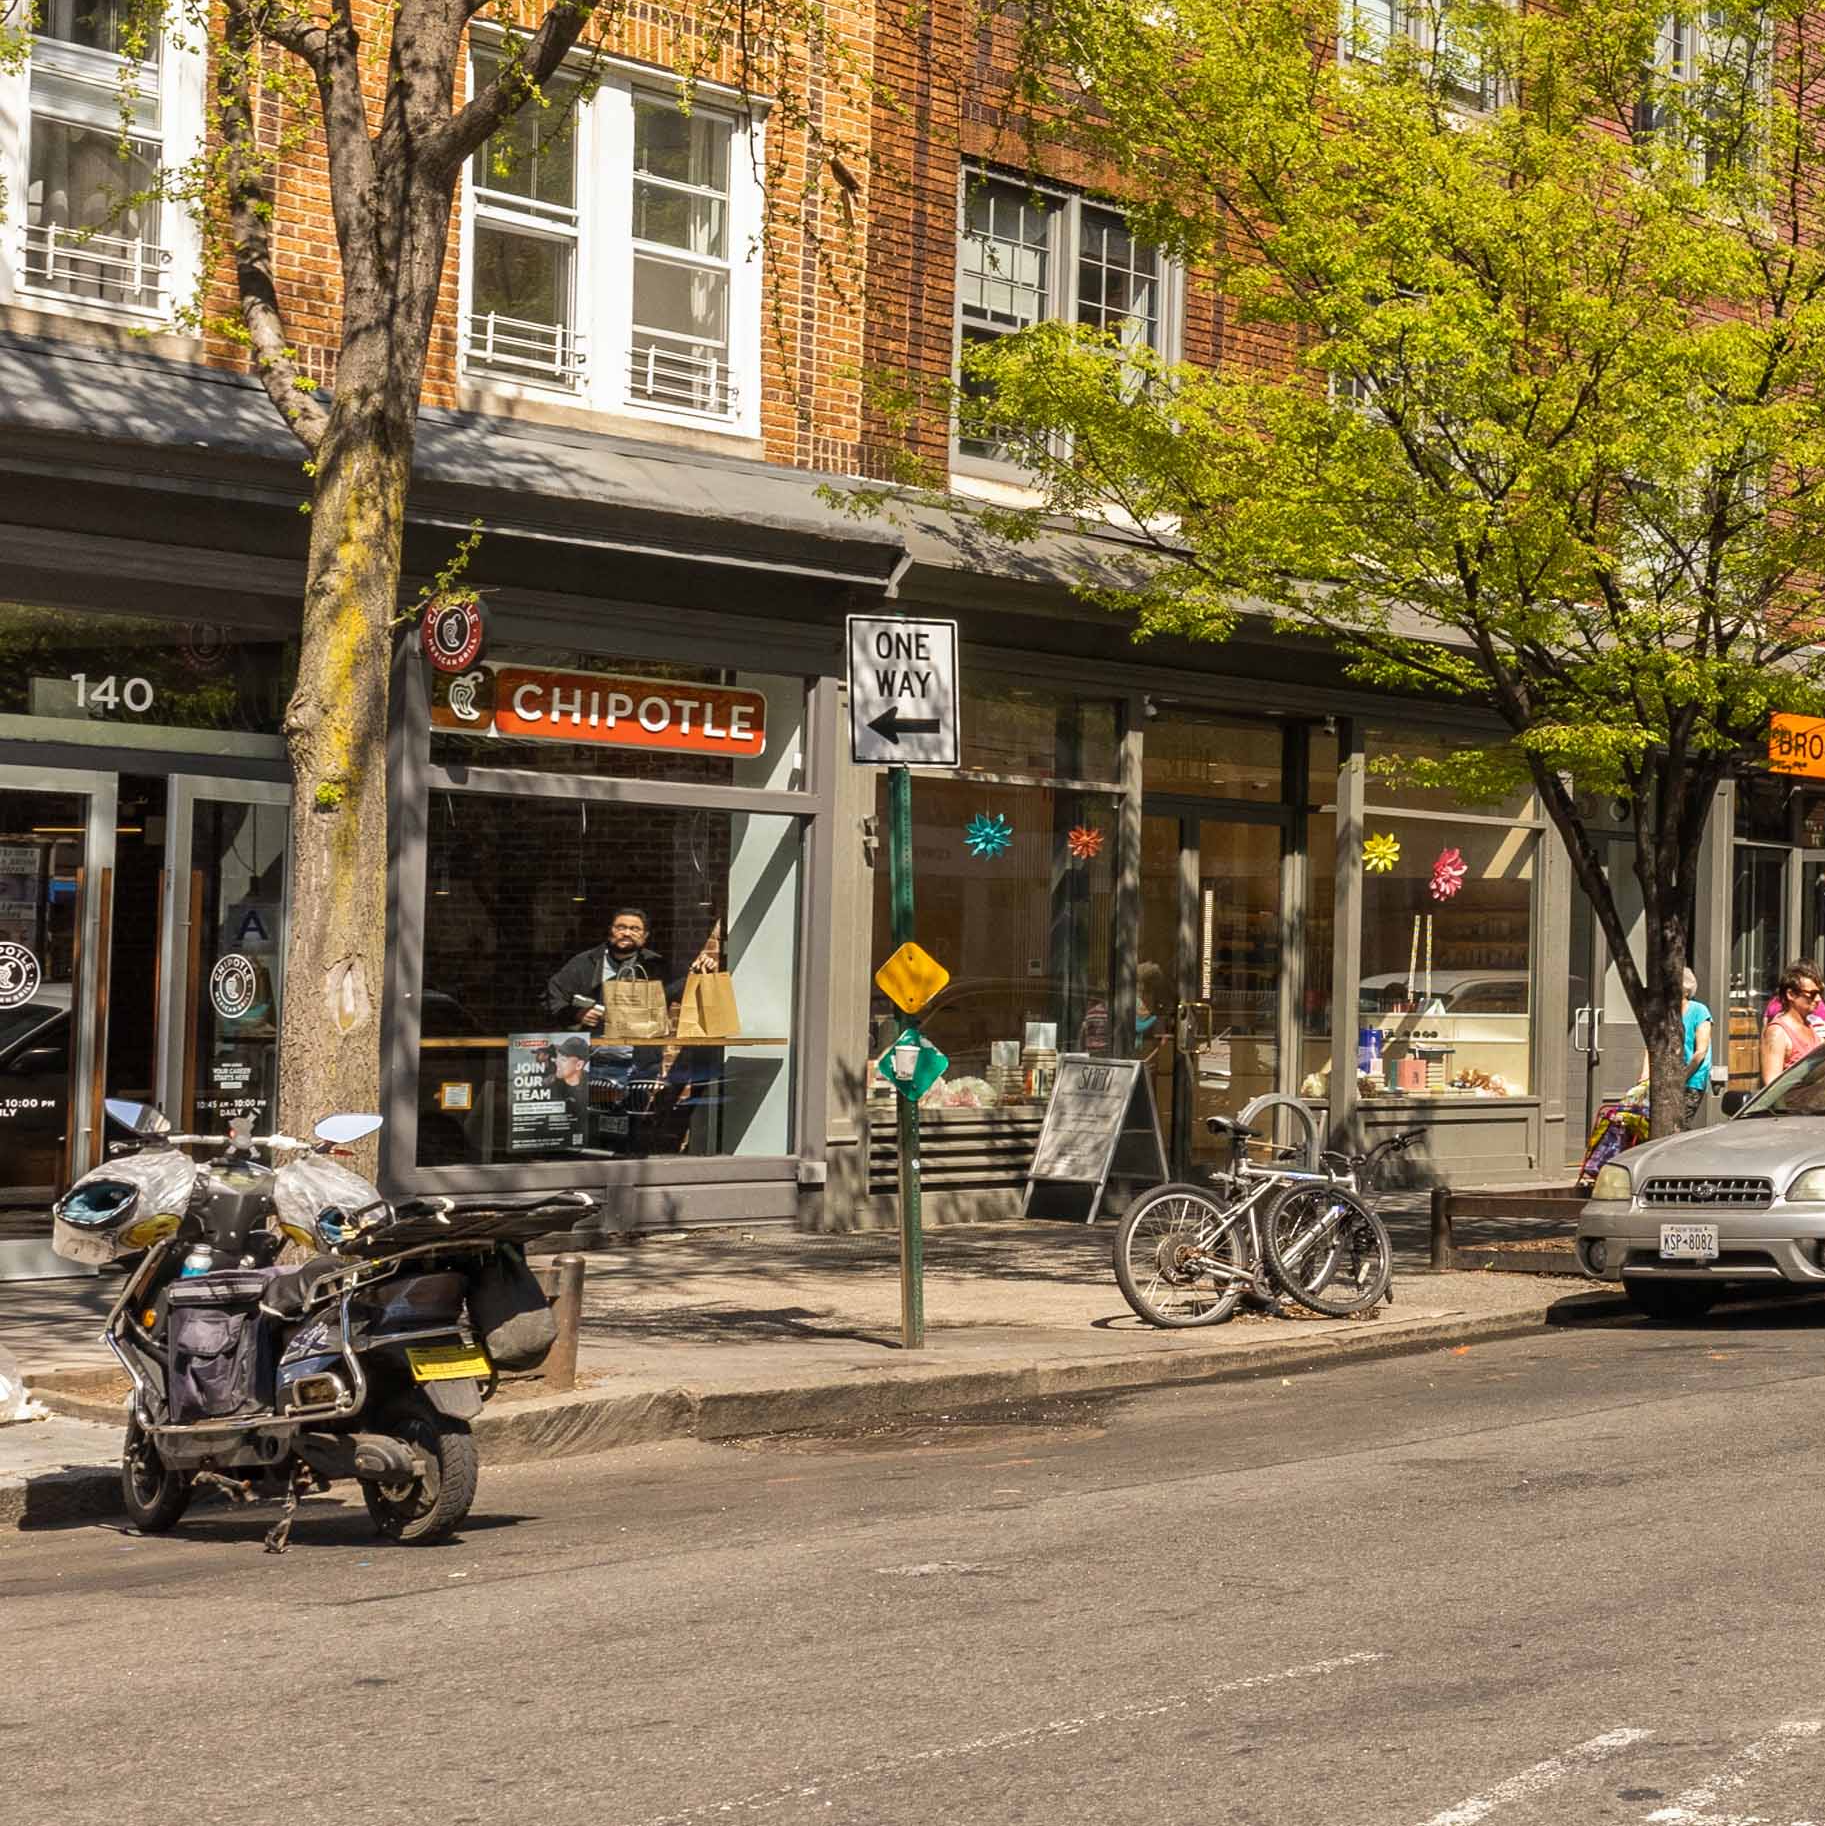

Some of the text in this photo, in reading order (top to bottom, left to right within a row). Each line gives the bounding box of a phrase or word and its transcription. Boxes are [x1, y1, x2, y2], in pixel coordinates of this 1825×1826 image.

[876, 630, 930, 660] ONE
[875, 669, 931, 699] WAY
[71, 673, 154, 712] 140
[513, 684, 755, 741] CHIPOTLE
[237, 910, 269, 940] A
[214, 957, 253, 982] CHIPOTLE
[213, 1067, 229, 1075] YOUR
[513, 1062, 546, 1074] JOIN
[513, 1075, 544, 1087] OUR
[513, 1088, 552, 1101] TEAM
[5, 1098, 56, 1109] 10:00 PM
[196, 1099, 218, 1109] 10:45
[233, 1098, 257, 1108] 10:00
[257, 1099, 267, 1107] PM
[219, 1108, 244, 1117] DAILY
